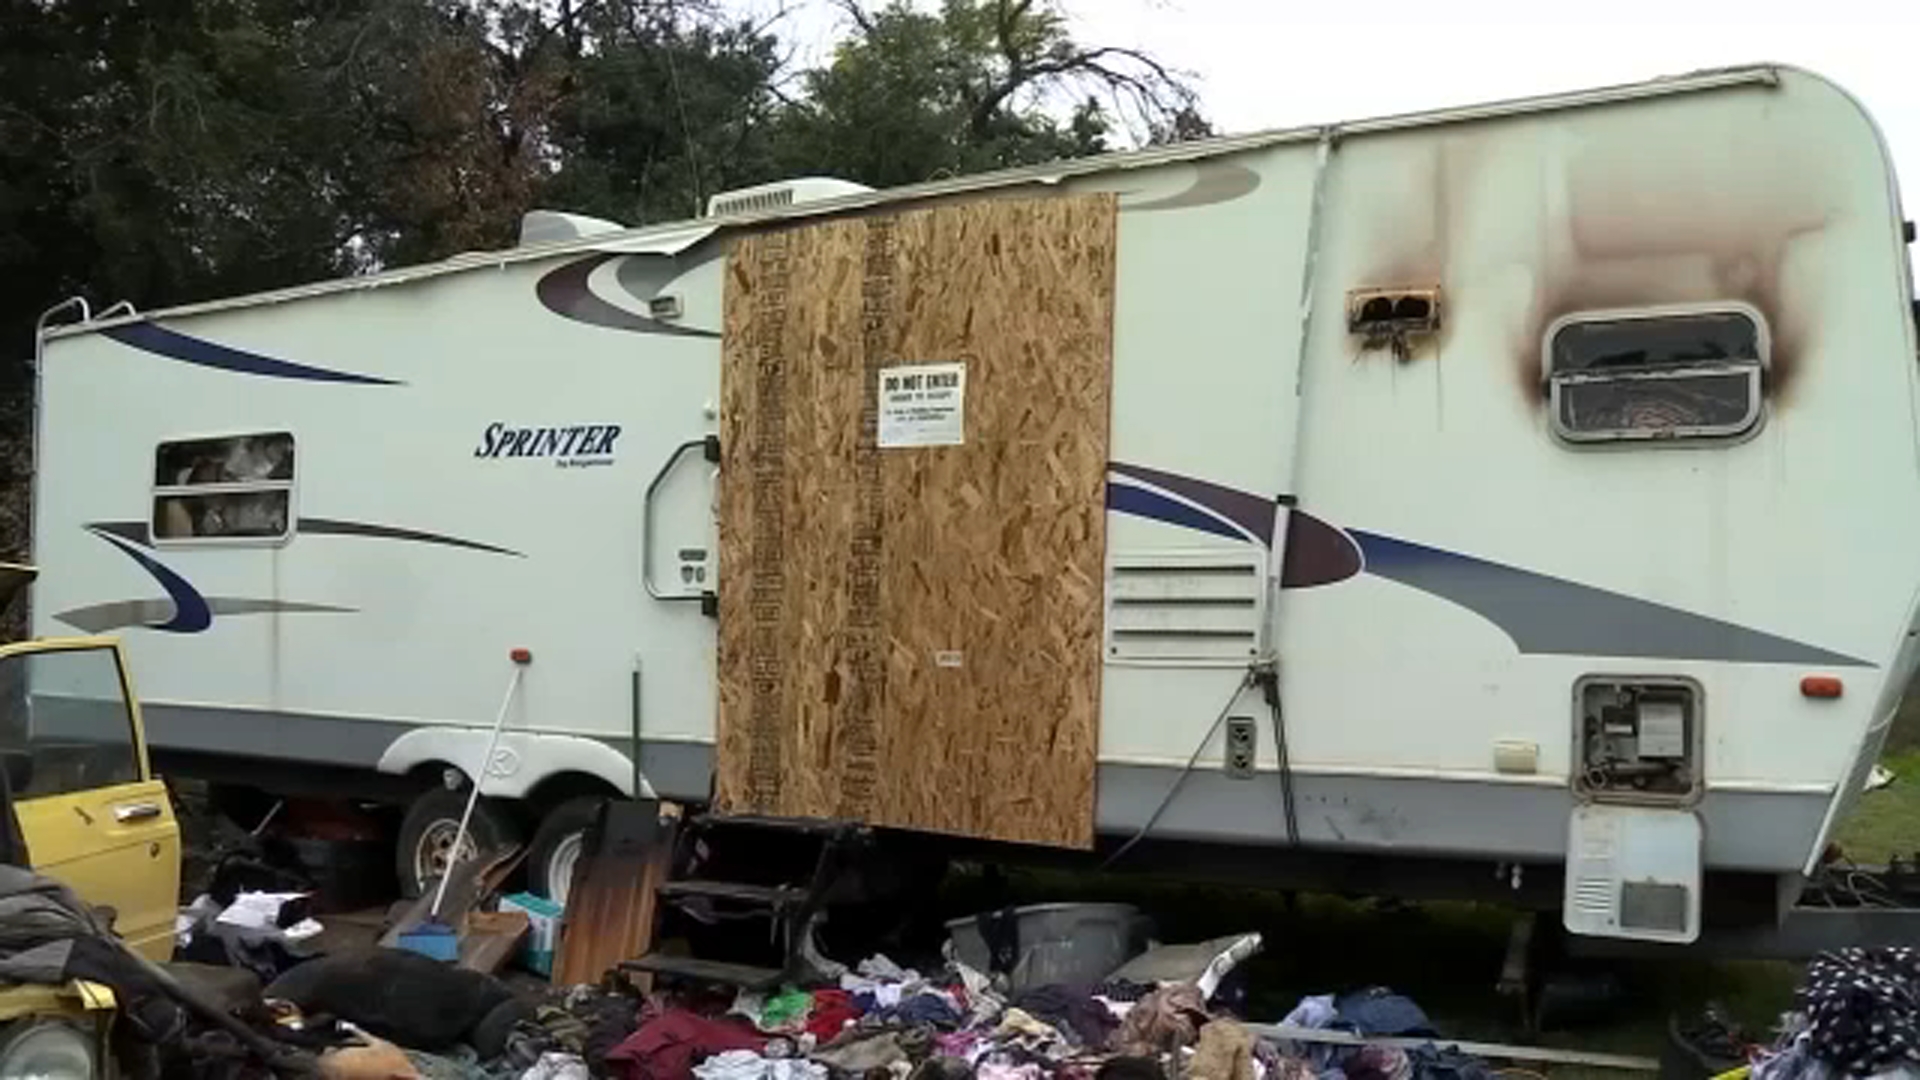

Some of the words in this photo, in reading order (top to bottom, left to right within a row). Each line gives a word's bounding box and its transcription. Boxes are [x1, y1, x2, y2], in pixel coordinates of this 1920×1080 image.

[885, 376, 900, 392] DO
[903, 374, 922, 391] NOT
[926, 371, 958, 389] ENTER
[474, 422, 621, 458] SPRINTER
